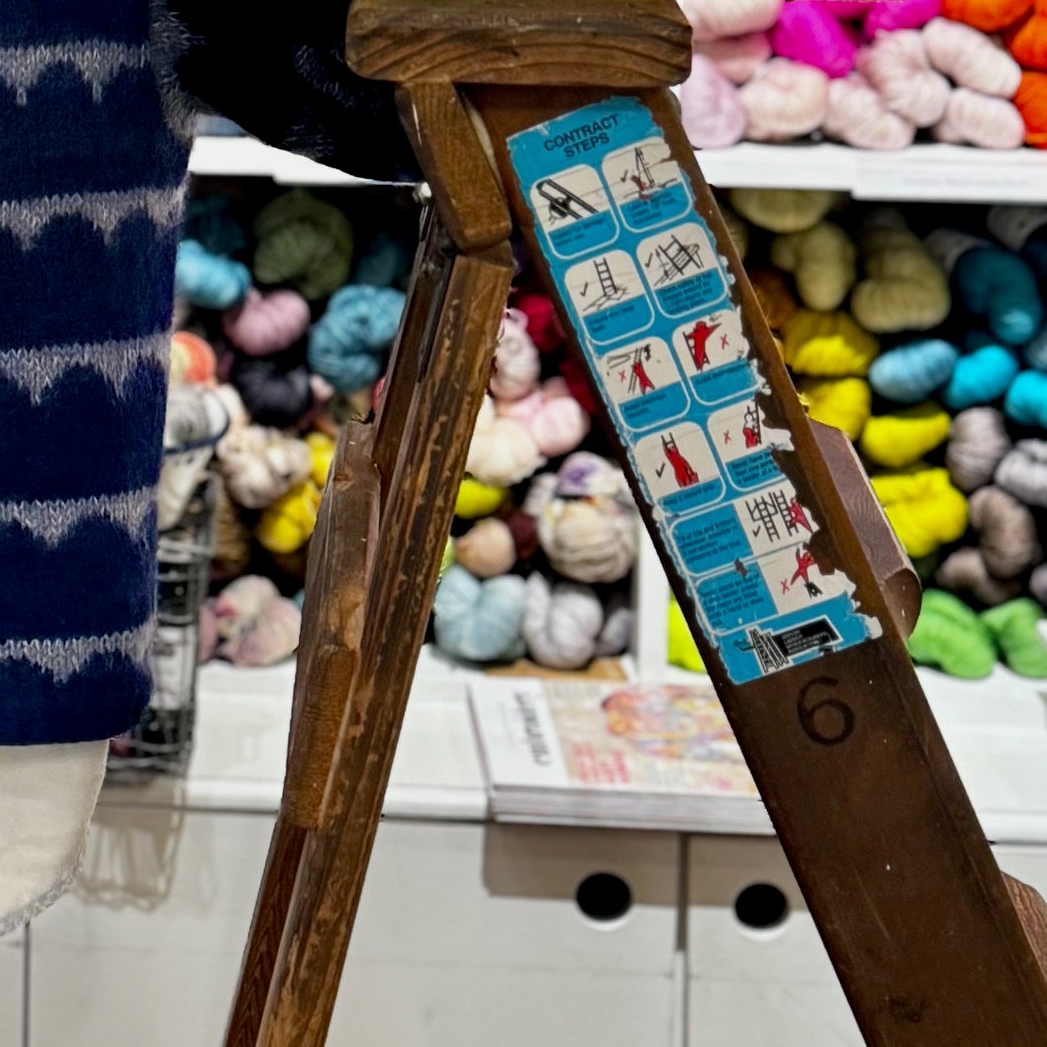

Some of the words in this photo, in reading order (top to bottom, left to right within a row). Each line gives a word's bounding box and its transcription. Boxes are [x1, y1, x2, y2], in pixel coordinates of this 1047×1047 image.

[544, 113, 619, 151] CONTRACT
[564, 132, 610, 158] STEPS
[797, 675, 855, 746] 6
